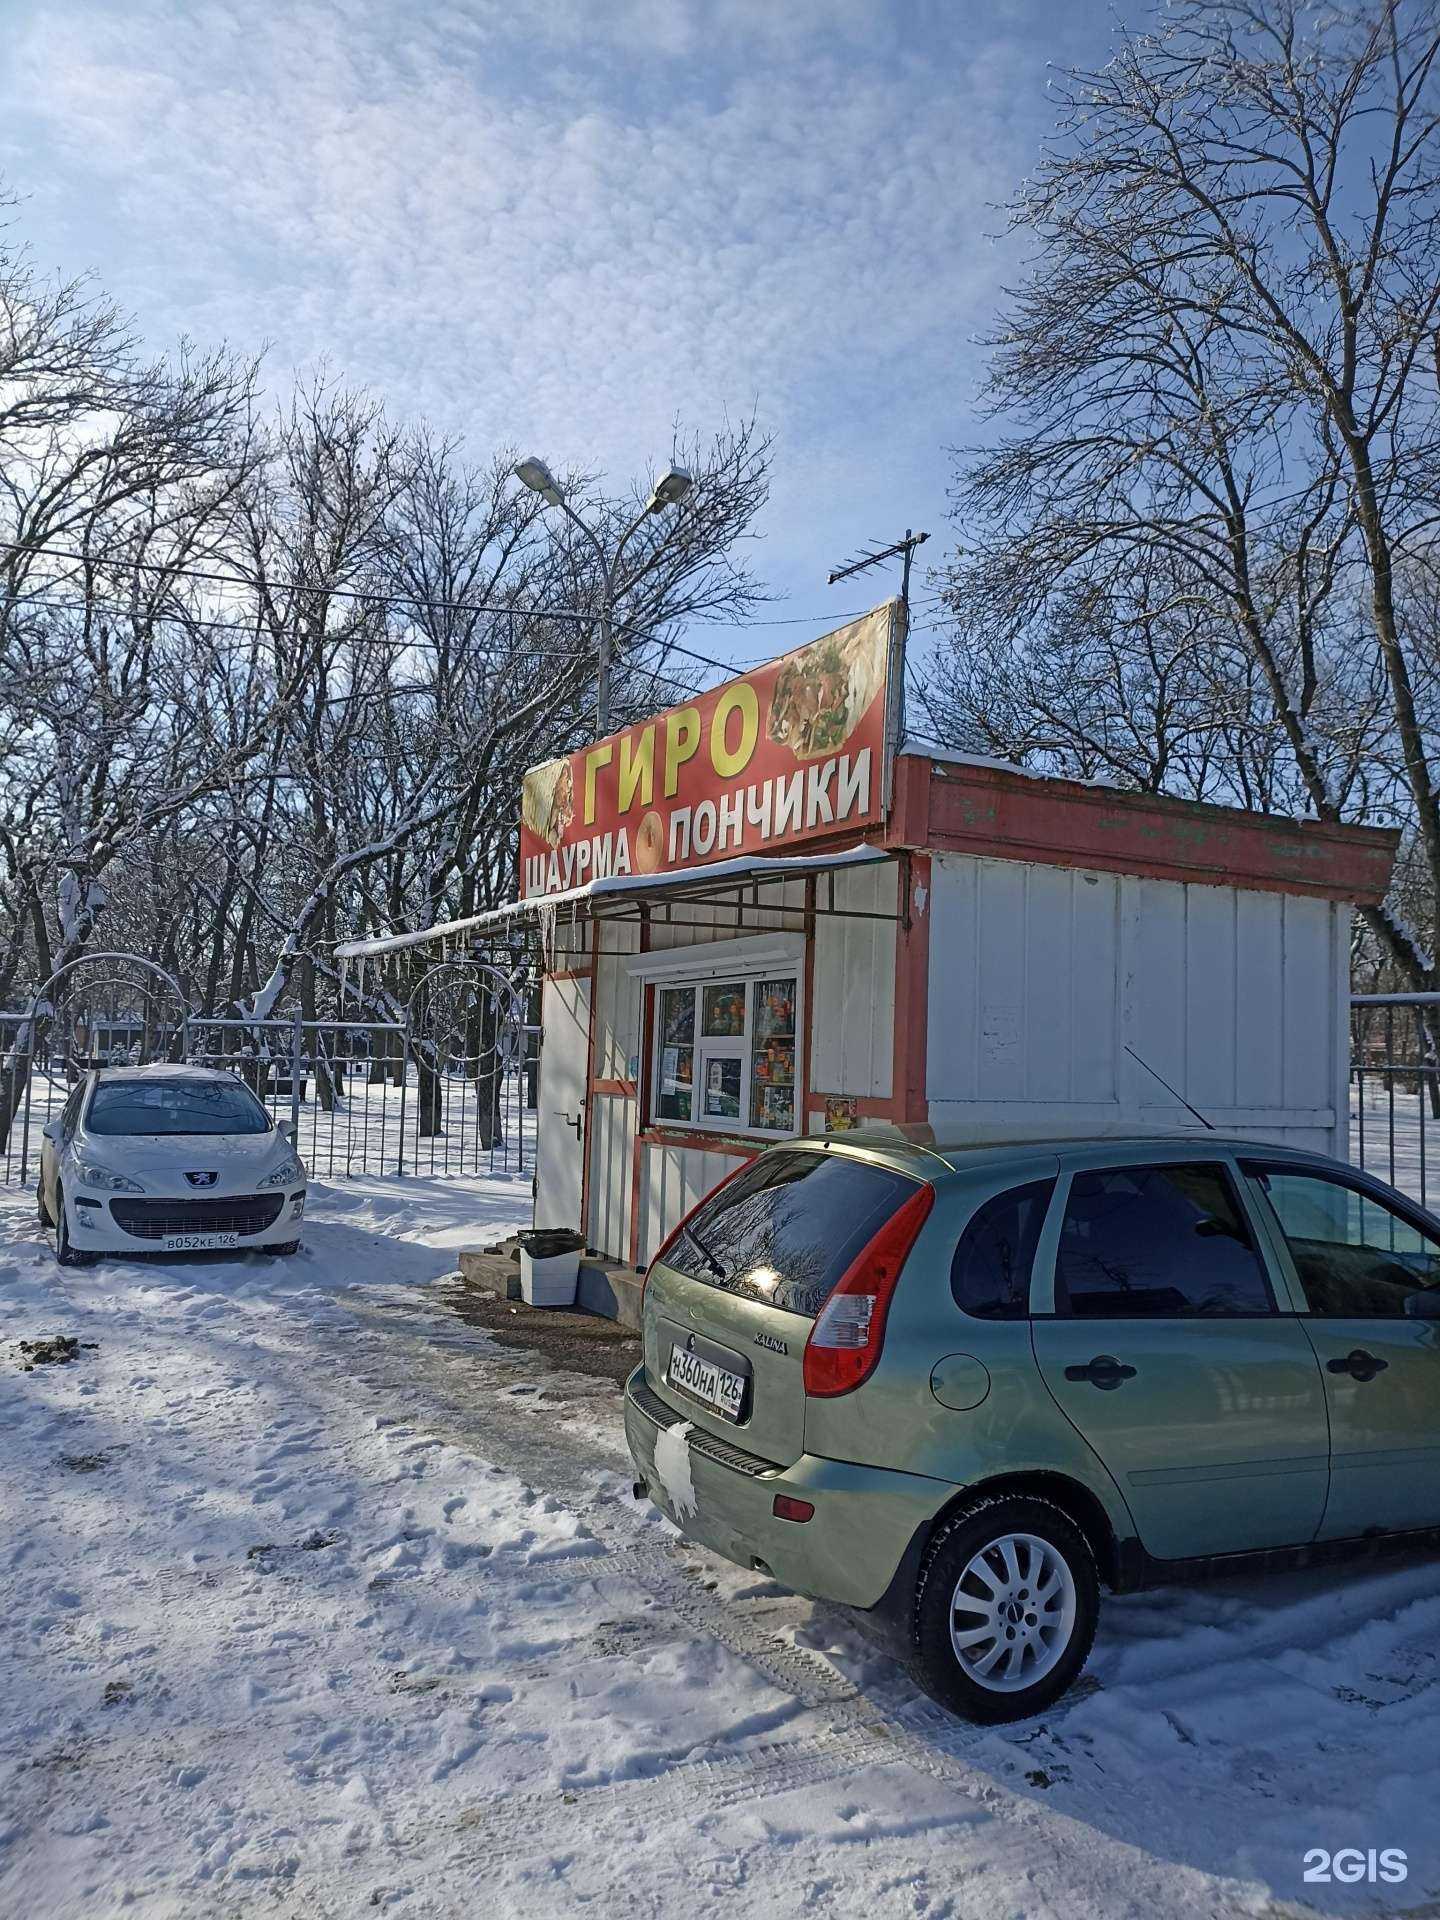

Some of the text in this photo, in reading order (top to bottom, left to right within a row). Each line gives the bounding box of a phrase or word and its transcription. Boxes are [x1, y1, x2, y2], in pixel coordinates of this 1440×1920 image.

[584, 682, 760, 826] ГИРО
[525, 747, 871, 899] ШАУРМА ПОНЧИКИ
[168, 1234, 236, 1249] В052КЕ 126
[754, 1332, 788, 1356] KALINA
[672, 1352, 715, 1398] Н360НА
[720, 1372, 739, 1400] 126
